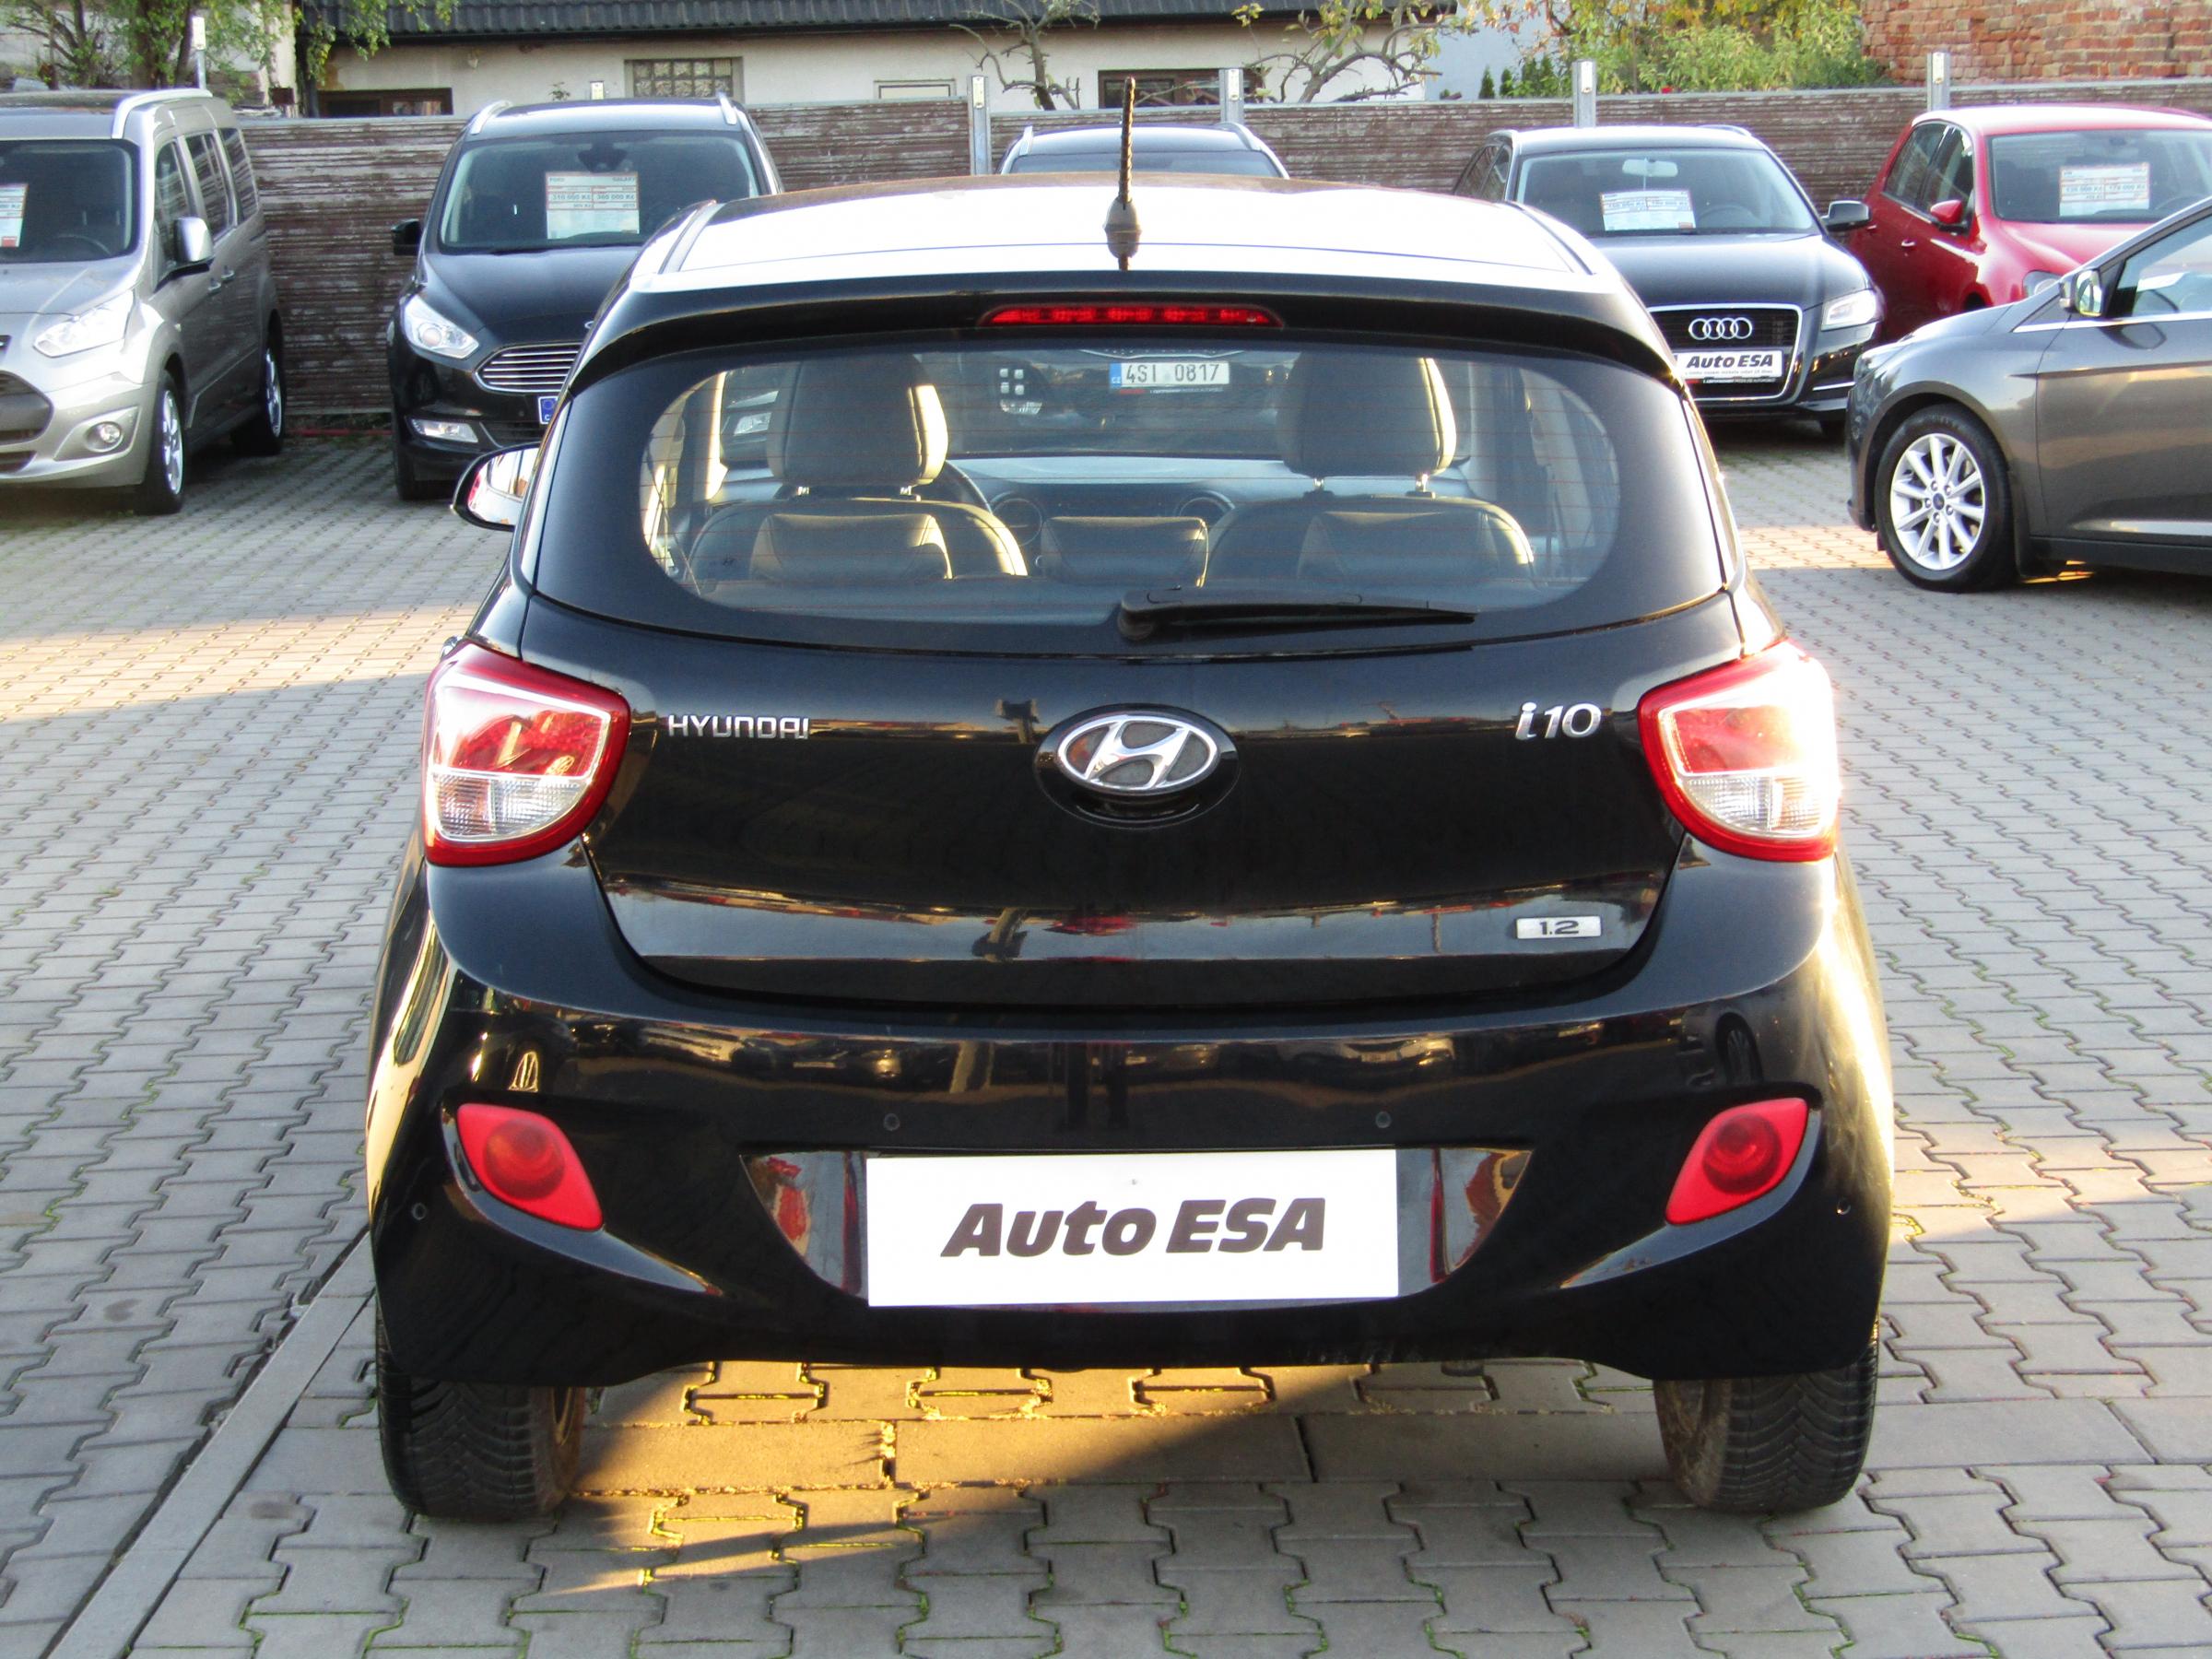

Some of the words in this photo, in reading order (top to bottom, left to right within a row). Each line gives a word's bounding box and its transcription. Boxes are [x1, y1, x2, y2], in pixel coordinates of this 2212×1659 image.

[1174, 363, 1219, 382] 0817
[1687, 355, 1735, 369] Auto
[1737, 354, 1773, 368] ESA
[668, 715, 809, 740] HYUNDAI
[1515, 701, 1602, 741] i10
[1539, 920, 1580, 935] 1.2
[939, 1200, 1158, 1258] Auto
[1165, 1197, 1326, 1254] ESA
